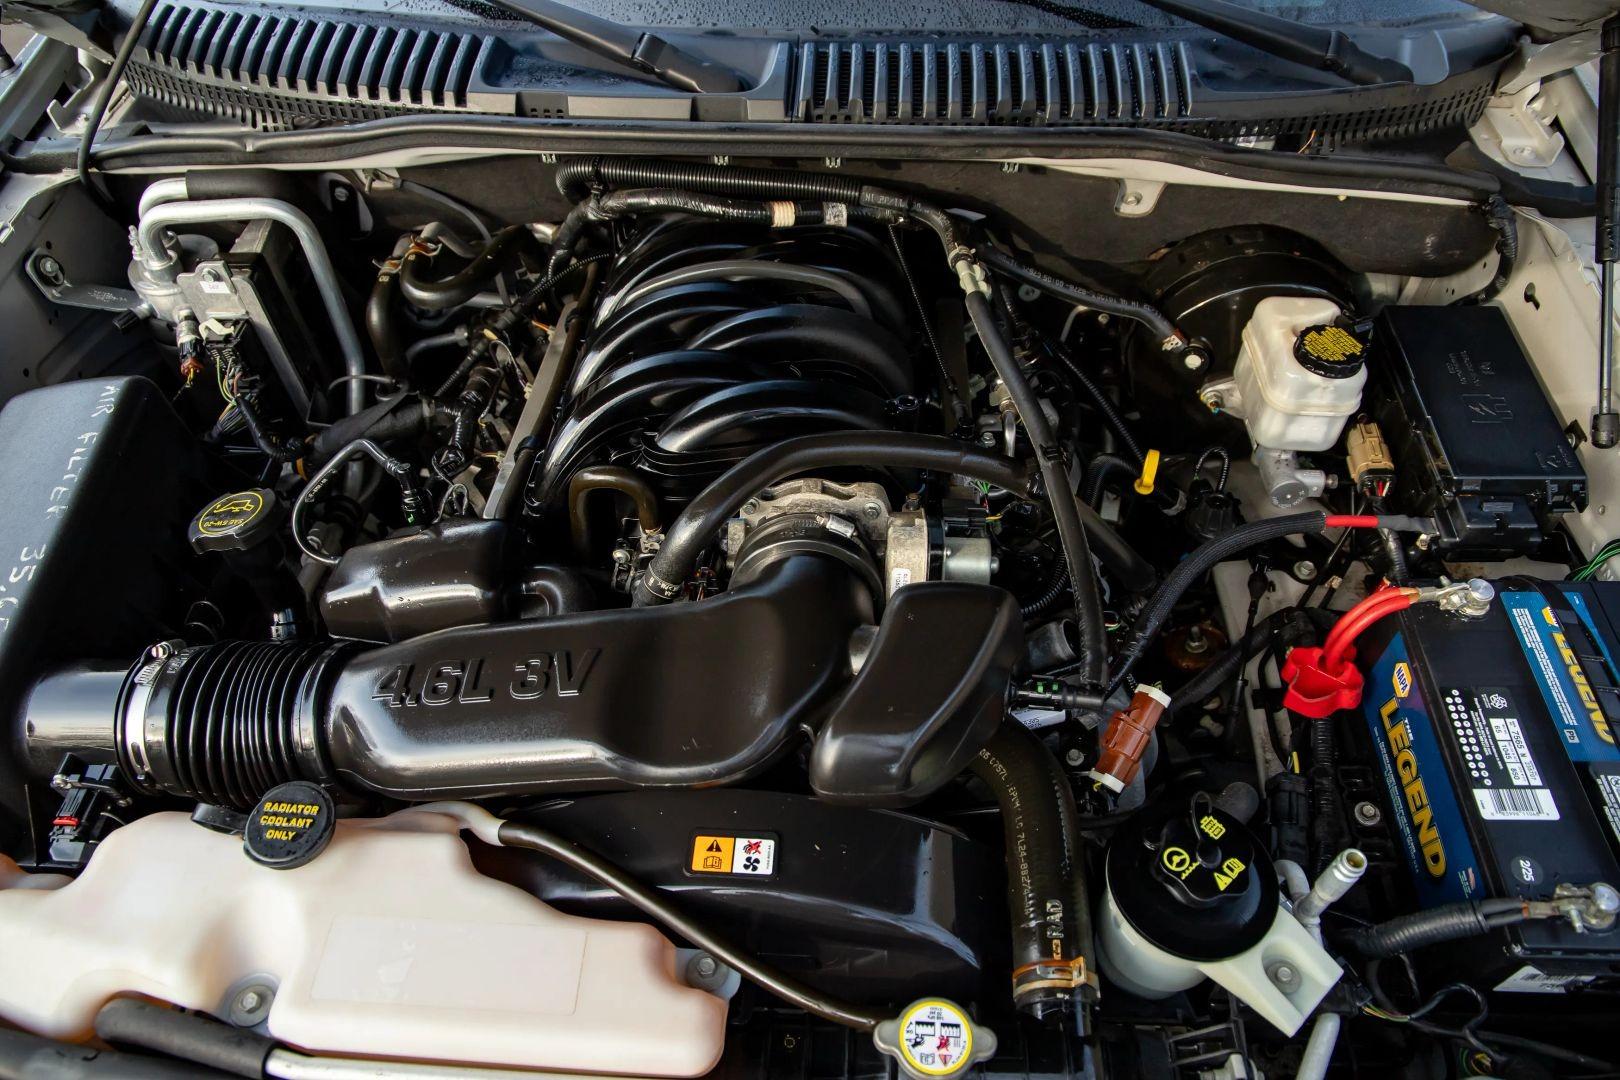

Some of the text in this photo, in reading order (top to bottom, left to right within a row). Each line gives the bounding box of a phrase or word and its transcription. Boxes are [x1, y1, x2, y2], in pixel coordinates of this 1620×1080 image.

[91, 385, 120, 417] AIR
[45, 431, 99, 520] FILTER
[371, 649, 602, 707] 4.6L 3V
[1395, 666, 1409, 693] NAPA
[1494, 725, 1502, 734] 65
[1566, 730, 1575, 741] Pb
[1501, 744, 1512, 760] 1045
[1379, 695, 1447, 878] LEGEND
[263, 802, 319, 816] RADIATOR
[260, 815, 313, 828] COOLANT
[265, 829, 296, 840] ONLY
[1518, 859, 1535, 882] 2/25
